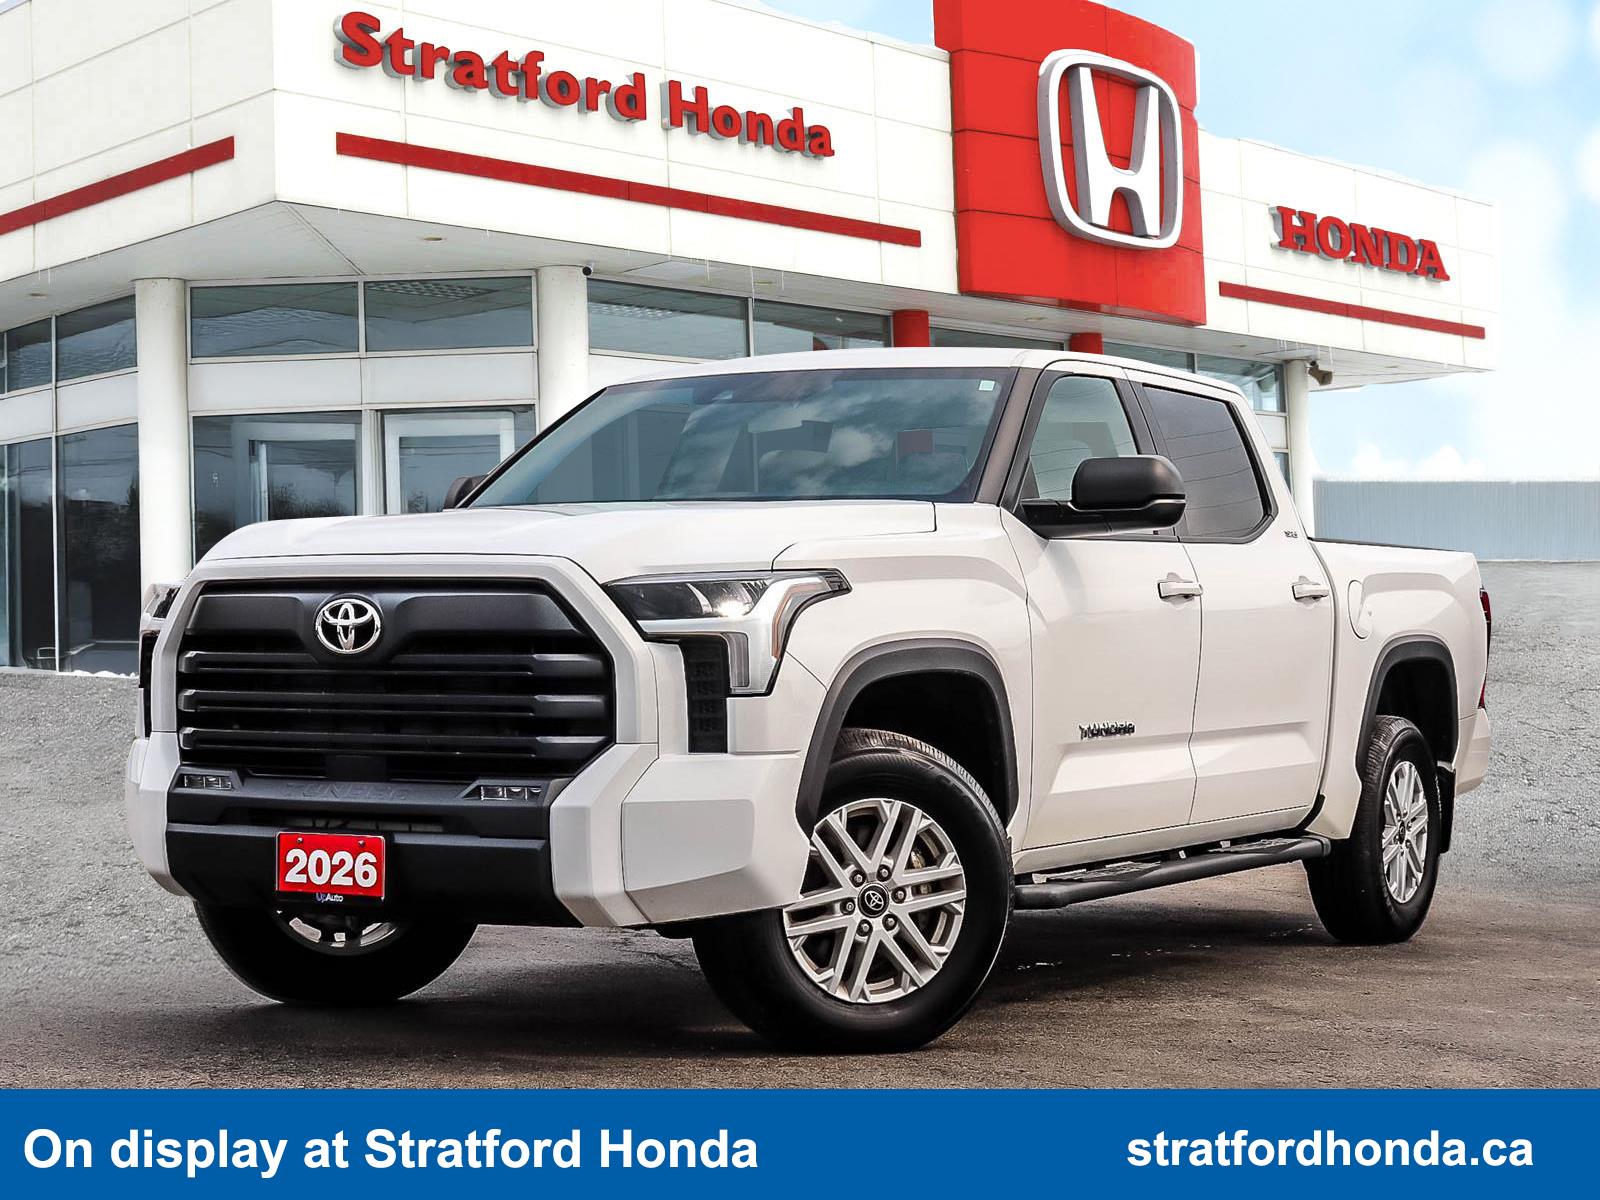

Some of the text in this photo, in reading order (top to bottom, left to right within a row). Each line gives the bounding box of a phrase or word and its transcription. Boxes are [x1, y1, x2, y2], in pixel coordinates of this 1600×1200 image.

[336, 11, 834, 157] Stratford Honda
[1275, 205, 1450, 281] HONDA
[285, 848, 377, 888] 2026
